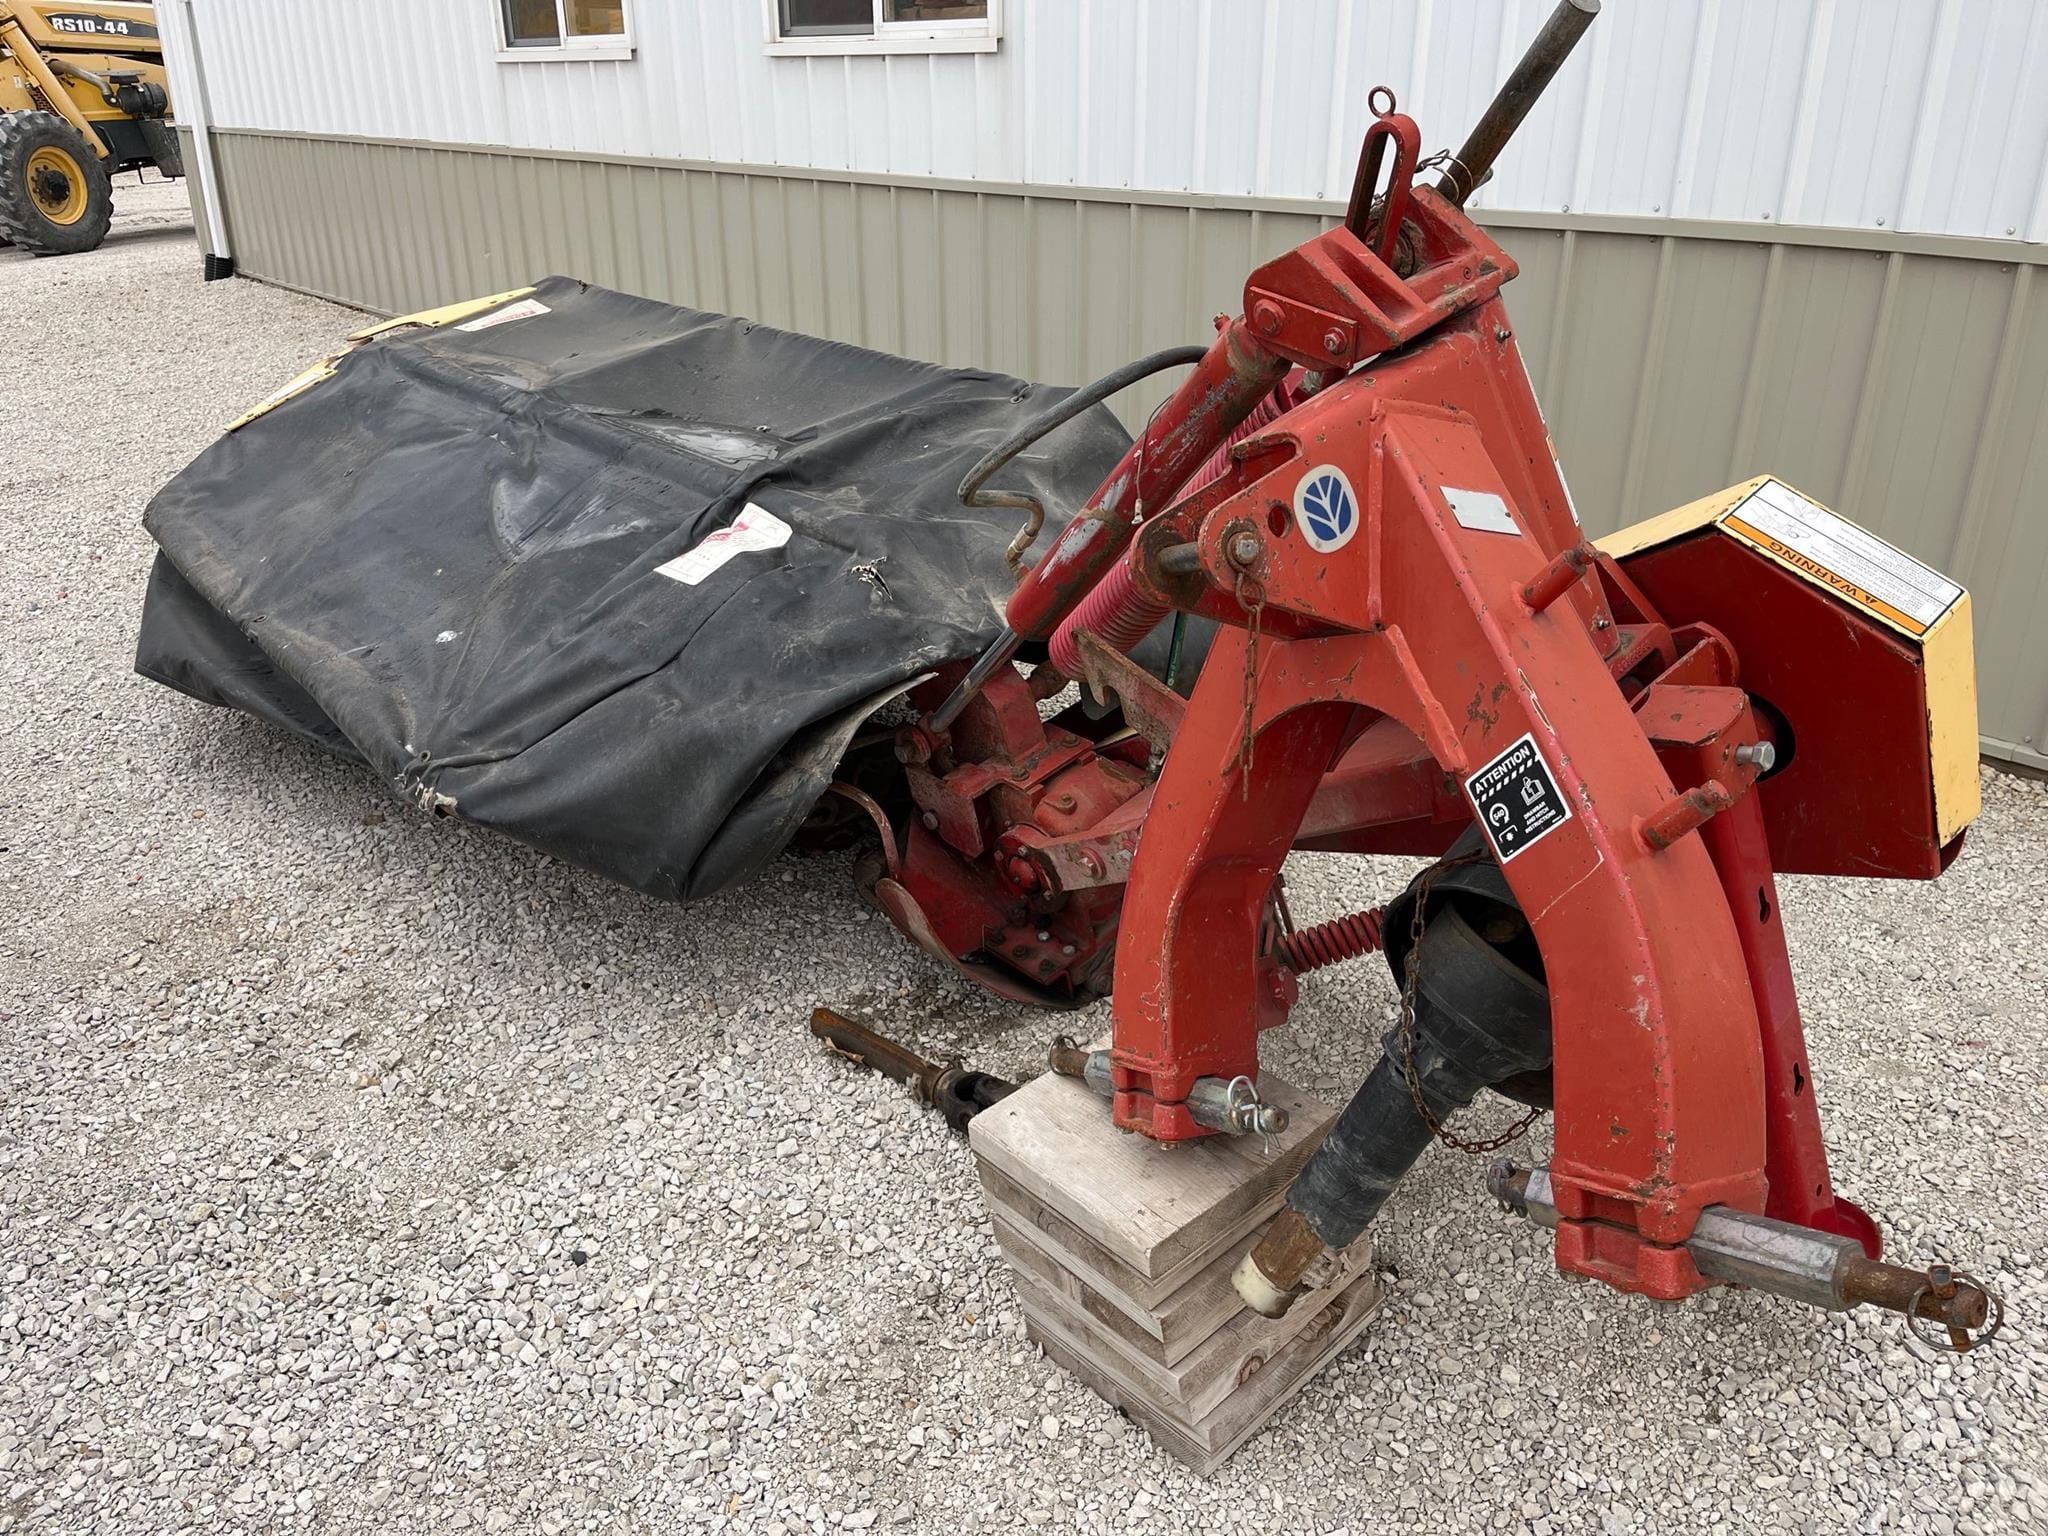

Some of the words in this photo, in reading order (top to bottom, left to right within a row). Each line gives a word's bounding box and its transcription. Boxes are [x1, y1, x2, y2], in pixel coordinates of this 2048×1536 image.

[51, 17, 129, 34] RS10-44
[1768, 540, 1858, 597] WARNING
[1474, 745, 1531, 795] ATTENTION
[1493, 809, 1505, 821] 540
[1523, 801, 1546, 820] DRAWBAR
[1524, 809, 1556, 834] INSTRUCTIONS
[1526, 815, 1536, 826] AND
